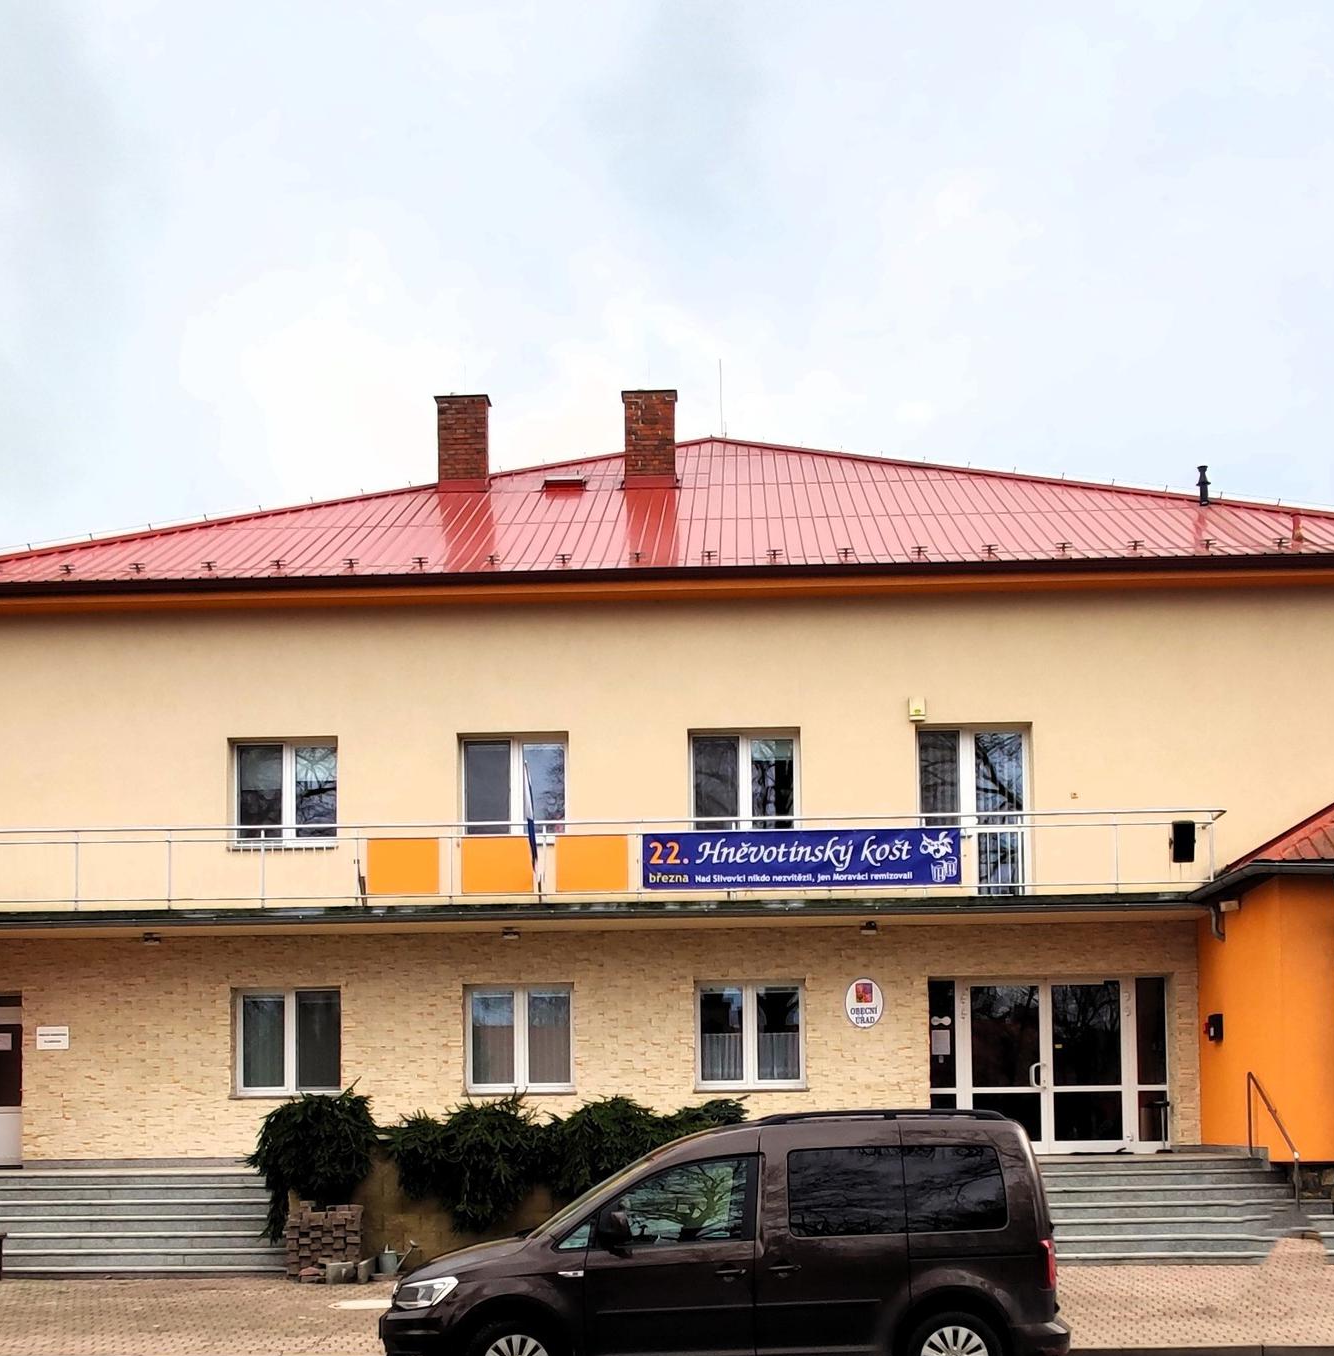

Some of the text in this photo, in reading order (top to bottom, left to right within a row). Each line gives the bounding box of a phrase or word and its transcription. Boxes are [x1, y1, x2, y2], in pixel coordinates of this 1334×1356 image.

[649, 835, 913, 872] 22. Hněvotínský košt
[649, 872, 689, 883] března
[695, 874, 711, 883] Nad
[747, 873, 771, 882] nikdo
[817, 873, 831, 883] jen
